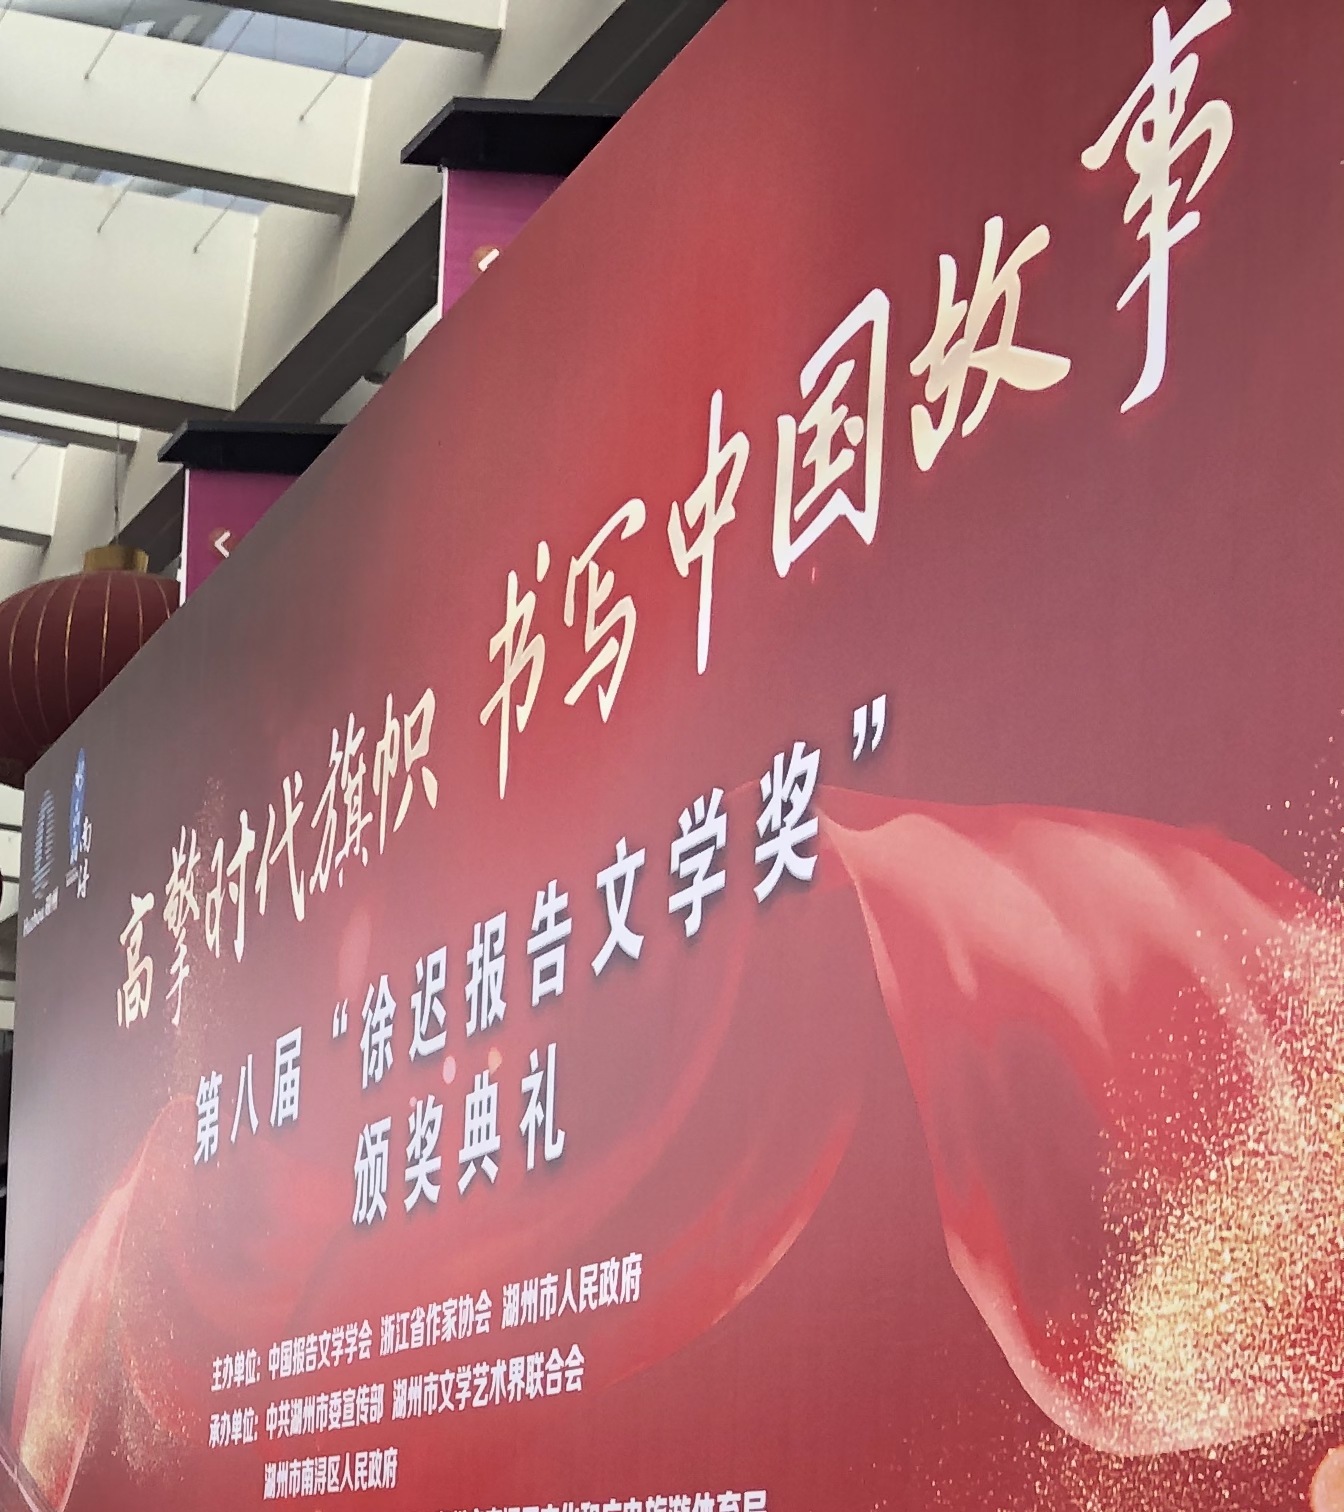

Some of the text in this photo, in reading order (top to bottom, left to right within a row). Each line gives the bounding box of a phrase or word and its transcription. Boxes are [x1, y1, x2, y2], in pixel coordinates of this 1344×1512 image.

[116, 0, 1234, 1030] 高擎时代旗帜 书写中国故事
[351, 1042, 567, 1227] 颁奖典礼
[379, 1288, 493, 1357] 浙江省作家协会
[500, 1251, 643, 1330] 湖州市人民政府
[391, 1343, 585, 1421] 湖州市文学艺术界联合会
[263, 1446, 399, 1501] 湖州市南浔区人民政府
